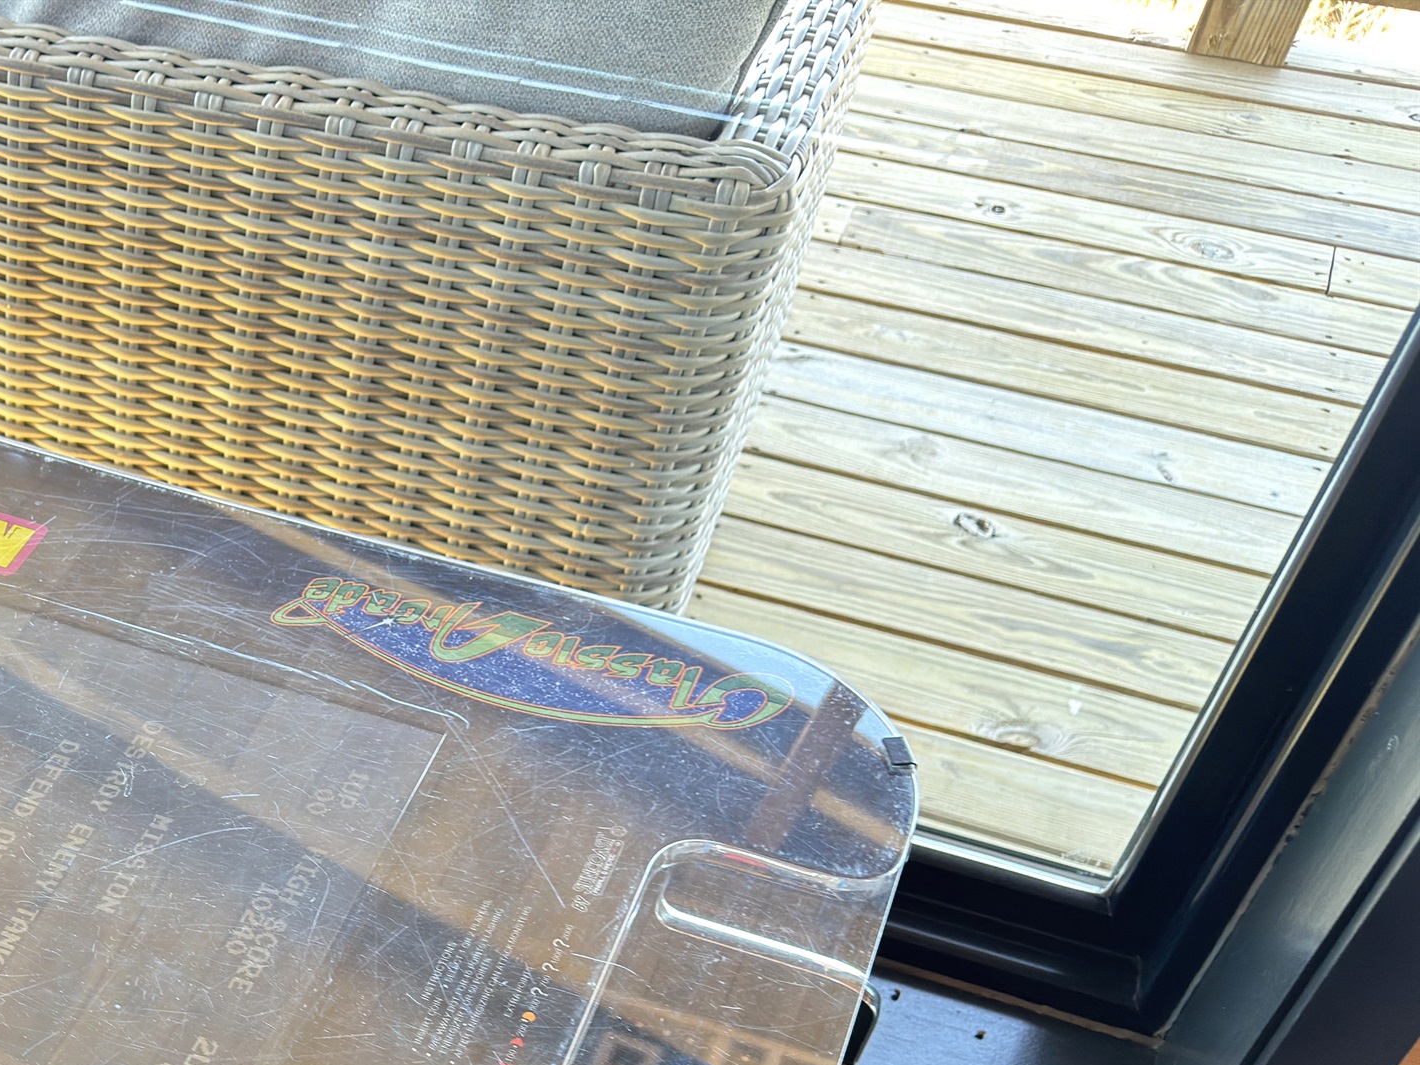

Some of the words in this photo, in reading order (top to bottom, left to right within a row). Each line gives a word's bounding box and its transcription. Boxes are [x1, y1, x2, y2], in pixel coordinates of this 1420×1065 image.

[302, 576, 553, 663] Arcade
[522, 631, 794, 729] Classic
[14, 739, 80, 817] DEFEND
[90, 720, 164, 812] DESTROY
[305, 788, 335, 817] 00
[339, 768, 371, 811] 1UP
[35, 822, 96, 894] ENEMY
[95, 813, 175, 915] MISSION
[279, 847, 329, 907] HIGH
[228, 919, 288, 995] SCORE
[420, 941, 457, 1000] INSTRUCTIONS
